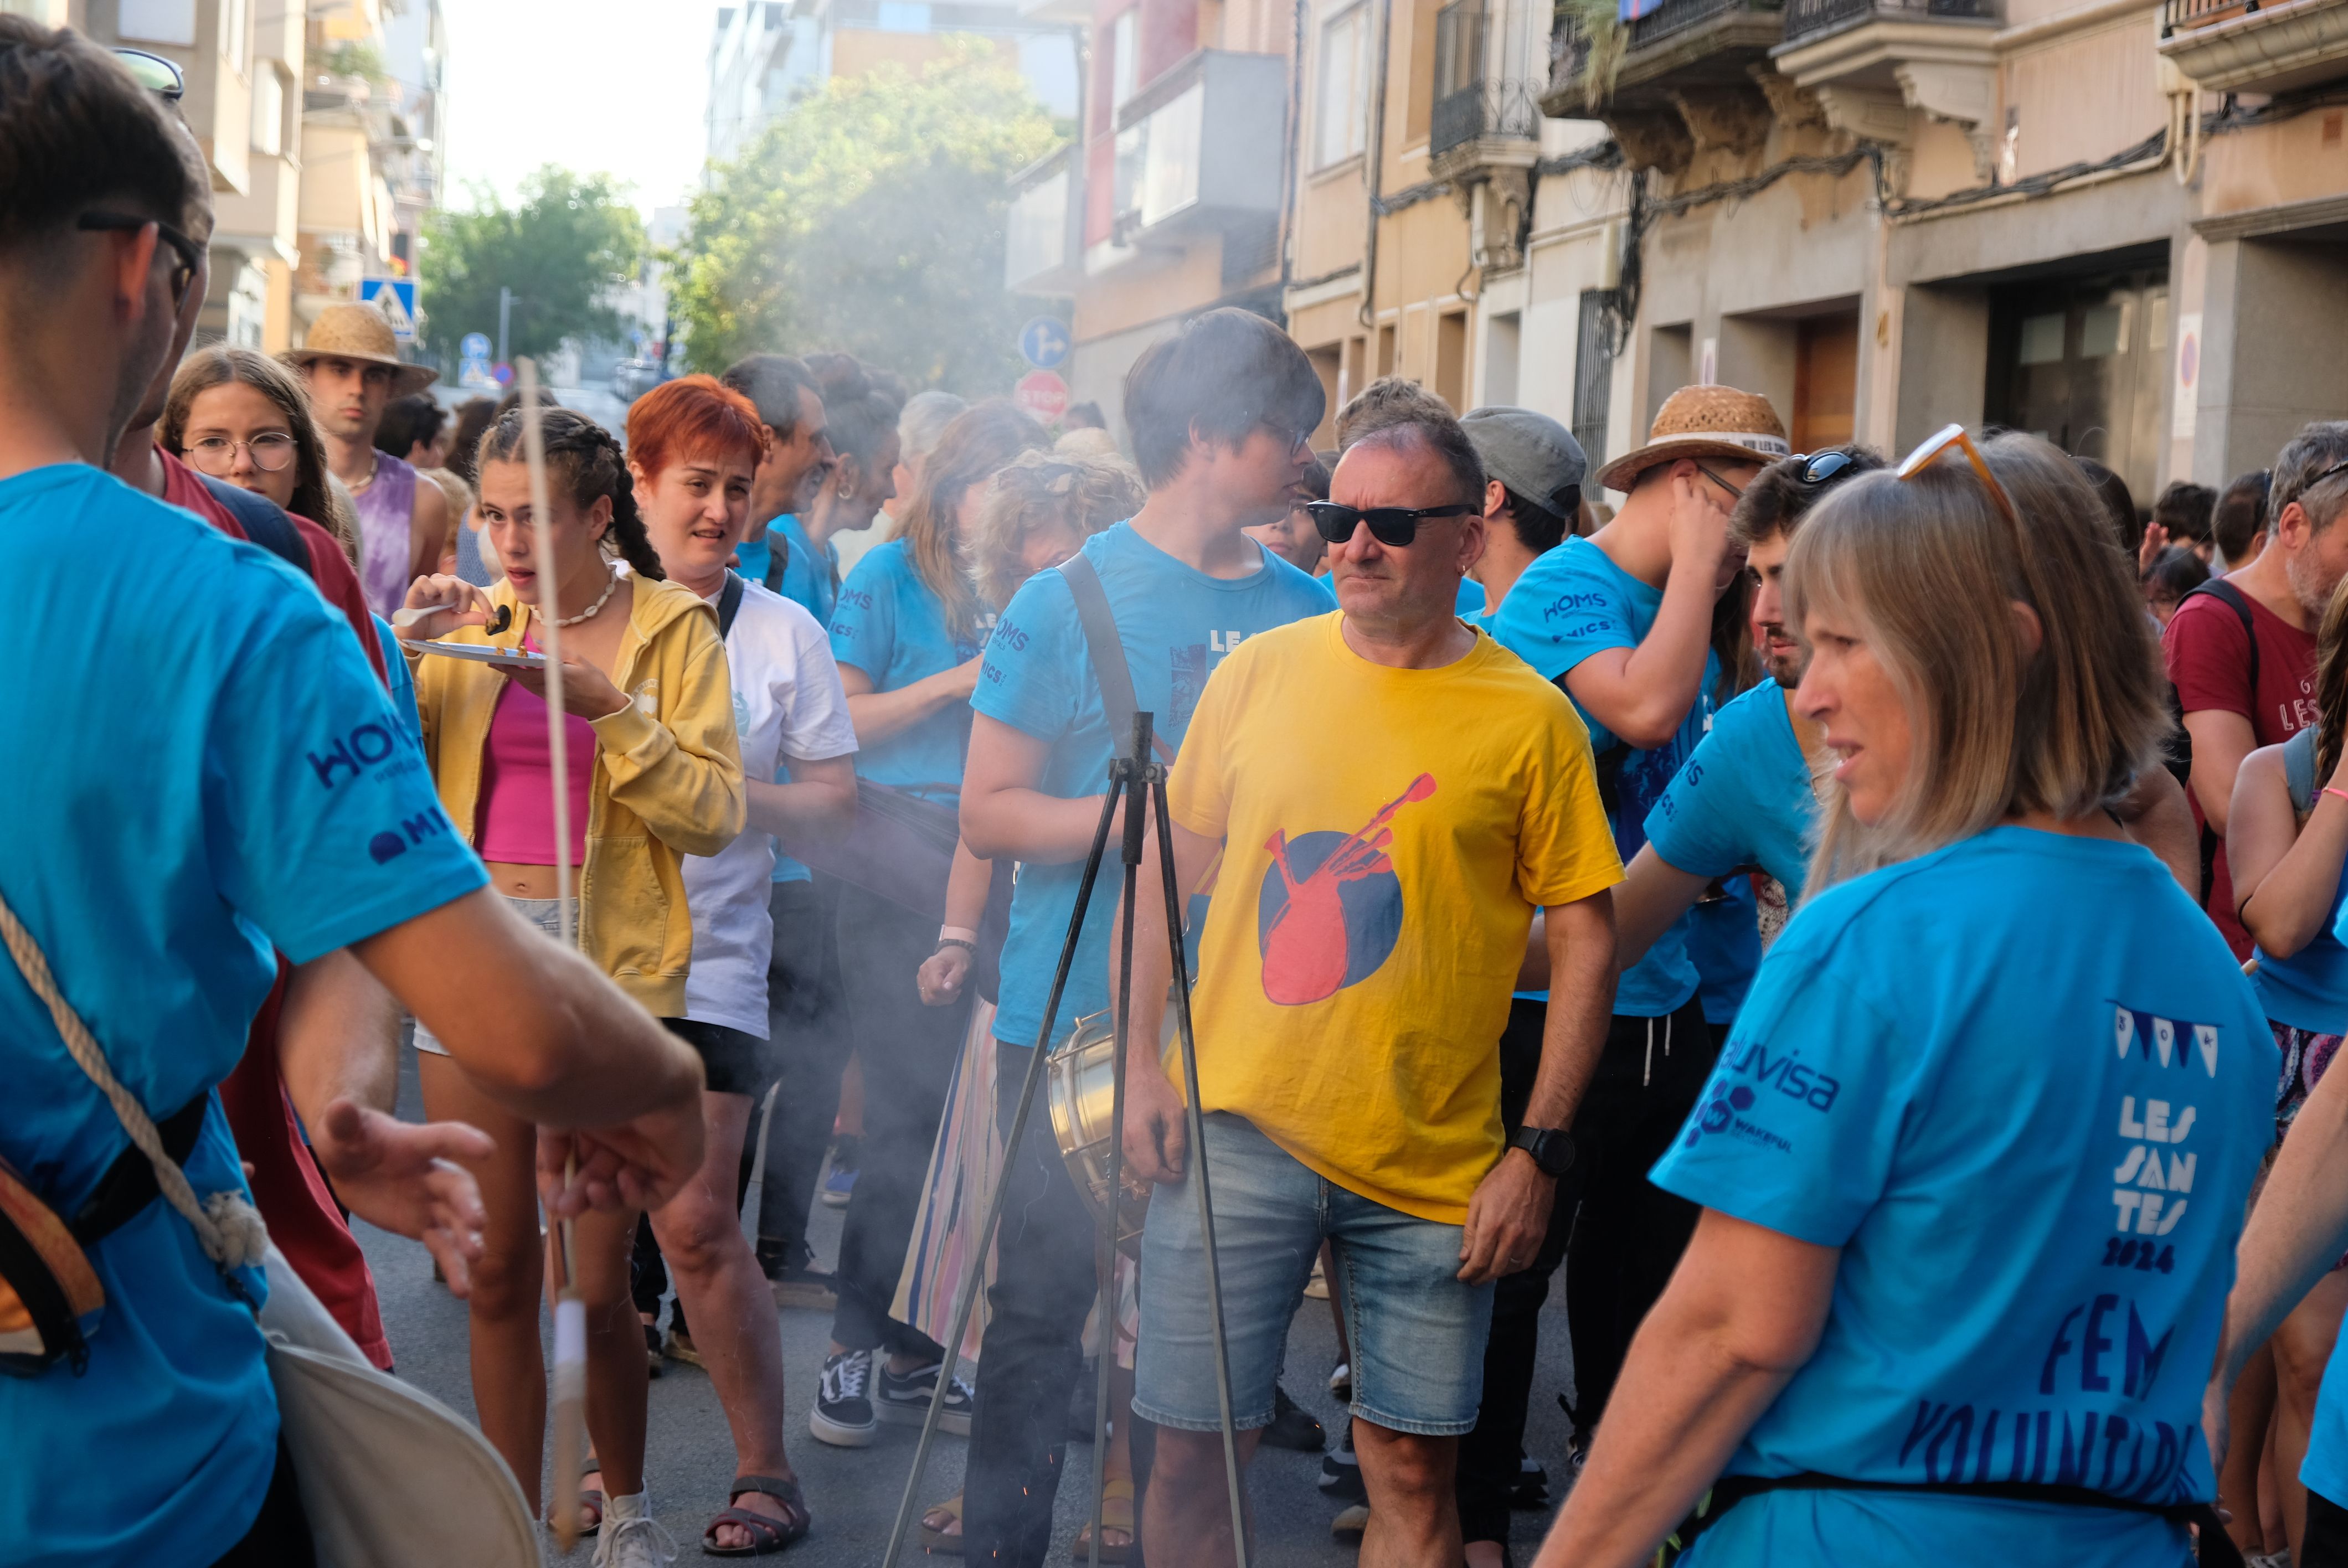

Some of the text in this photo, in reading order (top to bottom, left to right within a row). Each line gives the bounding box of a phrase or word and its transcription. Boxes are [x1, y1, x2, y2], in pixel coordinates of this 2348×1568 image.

[1020, 390, 1064, 405] STOP
[973, 613, 997, 629] LE
[1543, 593, 1607, 623] HOMS
[830, 621, 853, 637] ICS
[996, 617, 1030, 652] OMS
[1735, 1117, 1793, 1154] WAKEFUL
[2118, 1095, 2197, 1144] LES
[2113, 1144, 2198, 1194] SAN
[2112, 1188, 2188, 1237] TES
[2101, 1236, 2176, 1275] 2024
[2039, 1293, 2177, 1402] FEM
